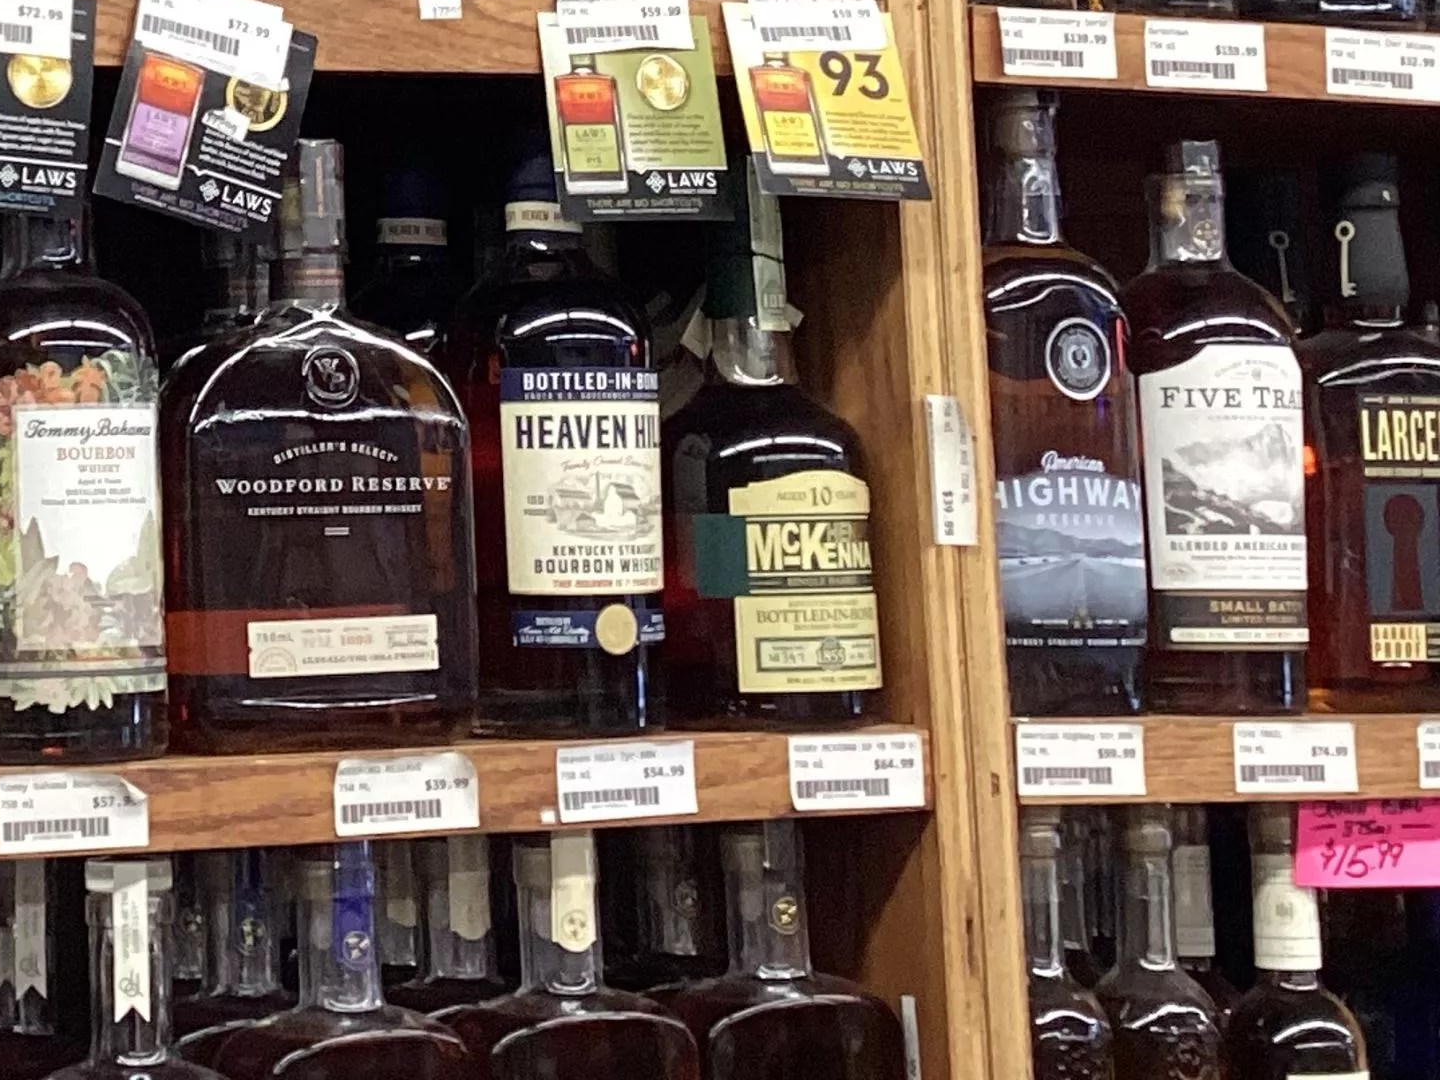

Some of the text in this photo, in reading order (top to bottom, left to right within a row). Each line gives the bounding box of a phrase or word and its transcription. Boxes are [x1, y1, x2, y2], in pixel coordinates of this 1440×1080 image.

[18, 6, 63, 20] $72.99
[641, 7, 681, 18] $59.99
[819, 51, 889, 100] 93
[868, 160, 918, 176] LAWS
[22, 167, 76, 188] LAWS
[668, 172, 717, 187] LAWS
[222, 186, 272, 215] LAWS
[523, 372, 658, 391] BOTTLED-IN-BON
[1161, 387, 1242, 409] FIVE
[25, 419, 96, 444] Tommy
[515, 414, 628, 450] HEAVEN
[1361, 409, 1440, 462] LARCE
[56, 446, 136, 462] BOURBON
[1041, 451, 1105, 473] American
[216, 476, 450, 495] WOODFORD RESERVE
[810, 487, 832, 507] 10
[1036, 513, 1114, 527] RESERVE
[553, 545, 614, 556] KENTUCKY
[1170, 540, 1288, 552] BLENDED AMERICAN
[534, 559, 614, 574] BOURBON
[1210, 601, 1264, 613] SMALL
[643, 765, 684, 779] $54.99
[425, 778, 469, 792] $39.99
[1321, 839, 1404, 878] $15.99
